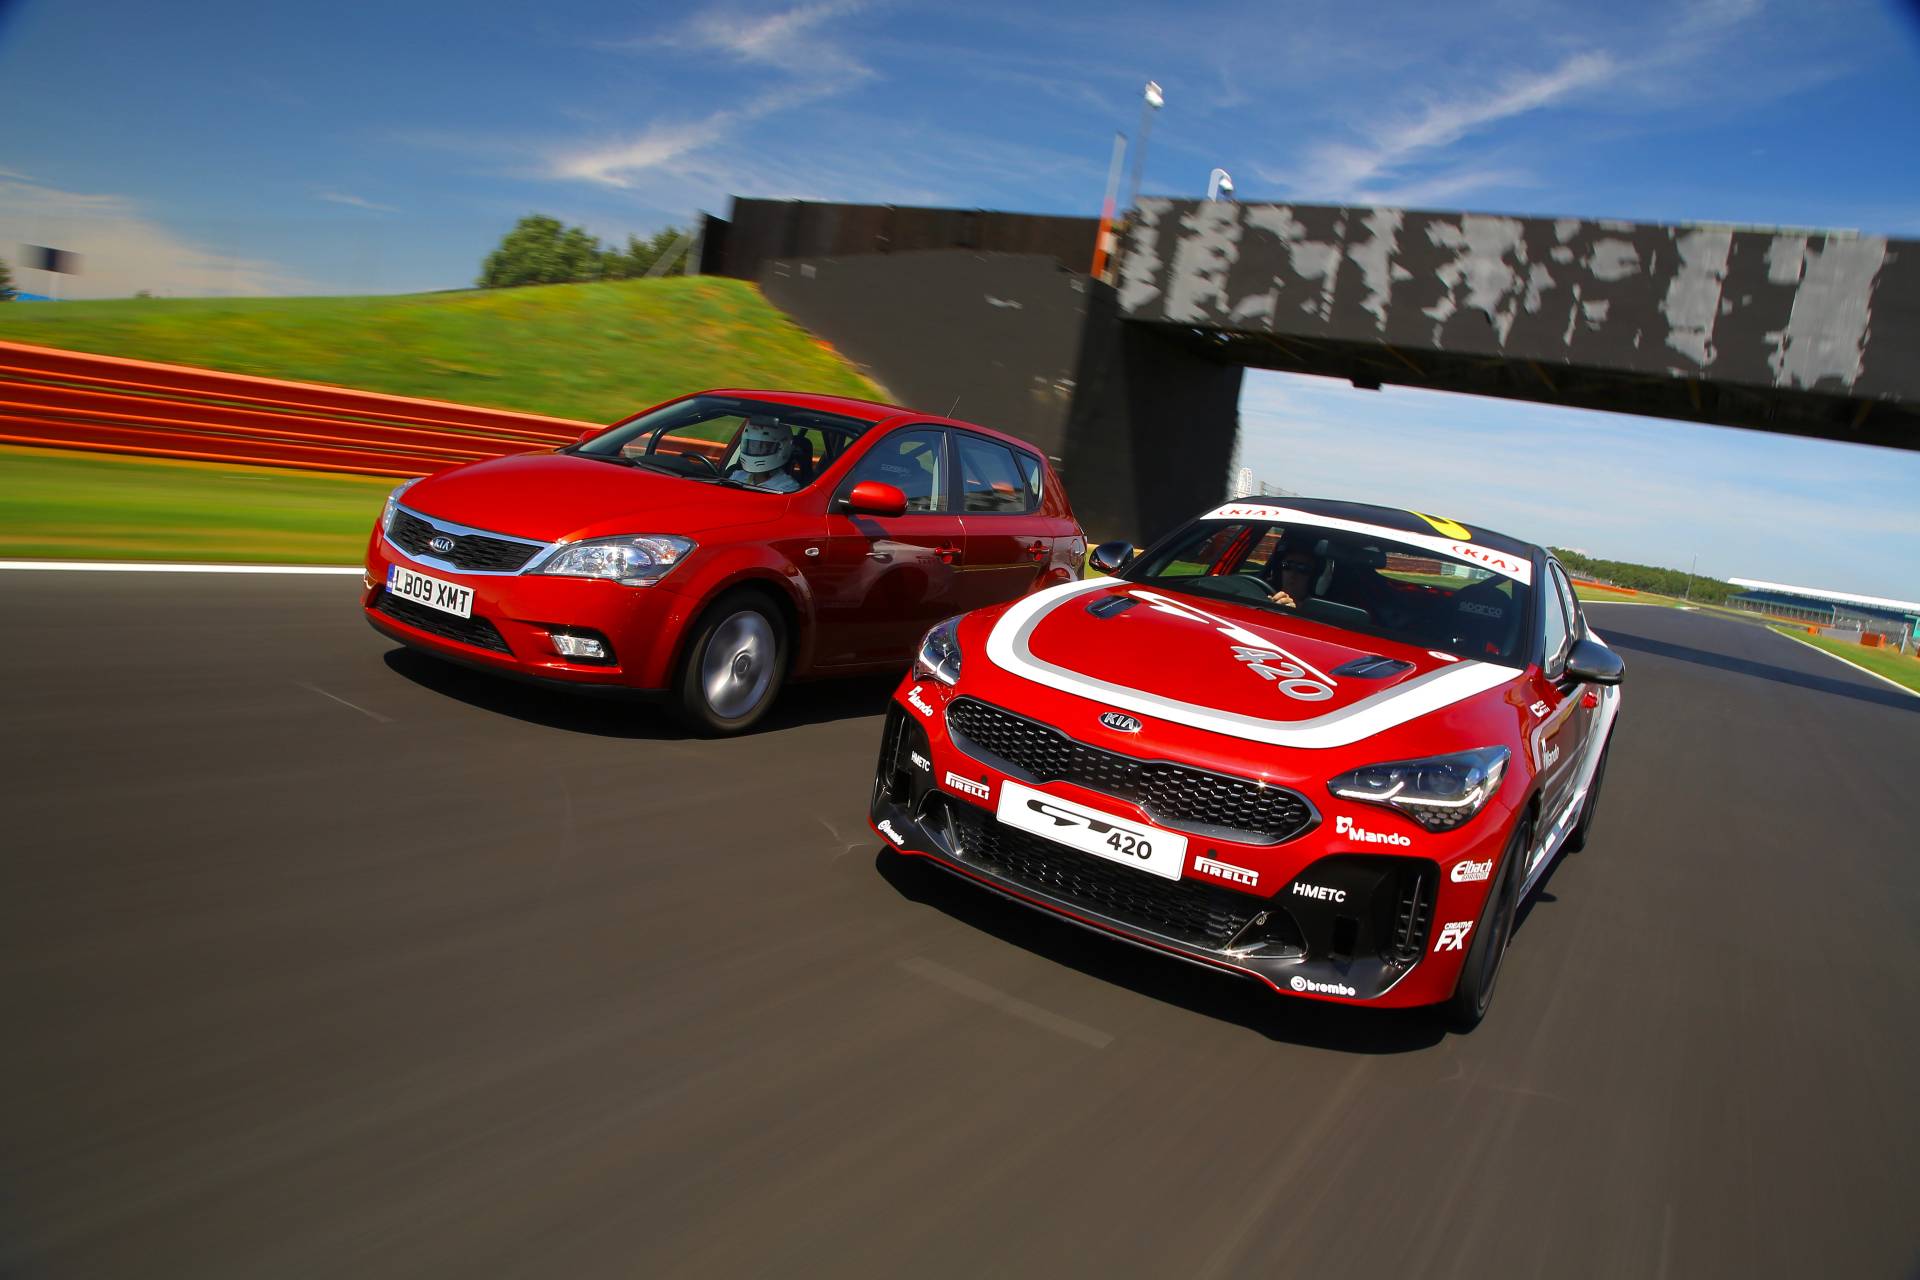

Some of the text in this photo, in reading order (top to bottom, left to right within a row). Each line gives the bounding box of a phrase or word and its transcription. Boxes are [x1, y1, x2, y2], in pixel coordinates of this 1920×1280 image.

[434, 538, 449, 551] KIA
[1463, 548, 1506, 569] KIA
[394, 569, 470, 613] LB09 XMT
[1459, 600, 1502, 619] sparco
[1230, 645, 1334, 702] 420
[1103, 712, 1135, 730] KIA
[910, 750, 931, 772] HMETC
[945, 770, 991, 801] PIRELLI
[1106, 832, 1153, 860] 420
[1349, 828, 1411, 847] Mando
[1194, 855, 1259, 887] PIRELLI
[1292, 881, 1346, 903] HMETC
[1433, 928, 1470, 953] FX
[1306, 979, 1356, 997] brembo
